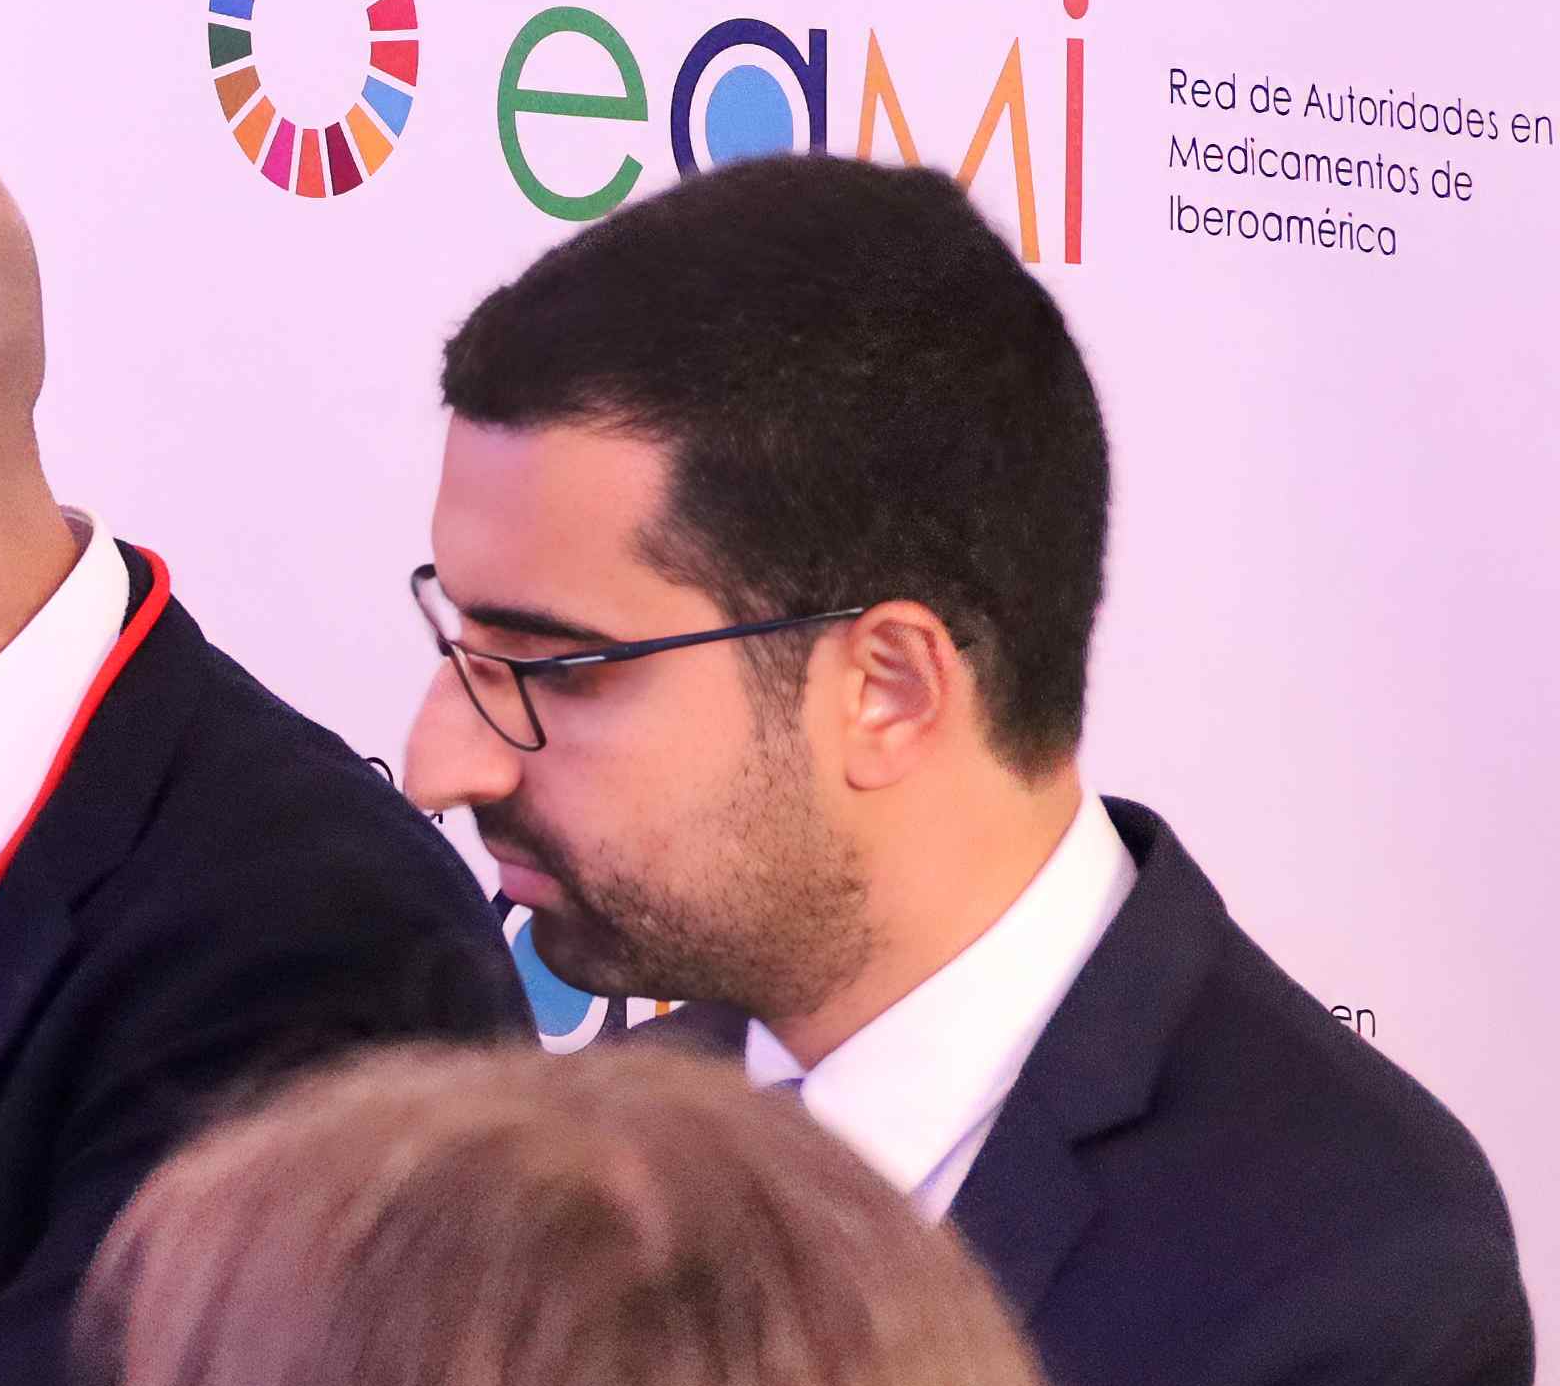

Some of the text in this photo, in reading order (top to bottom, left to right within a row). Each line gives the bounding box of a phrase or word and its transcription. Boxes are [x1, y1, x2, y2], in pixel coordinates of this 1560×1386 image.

[1170, 68, 1552, 144] Red de Autoridades en
[1169, 141, 1473, 202] Medicamentos de
[1171, 201, 1397, 256] Iberoamérica
